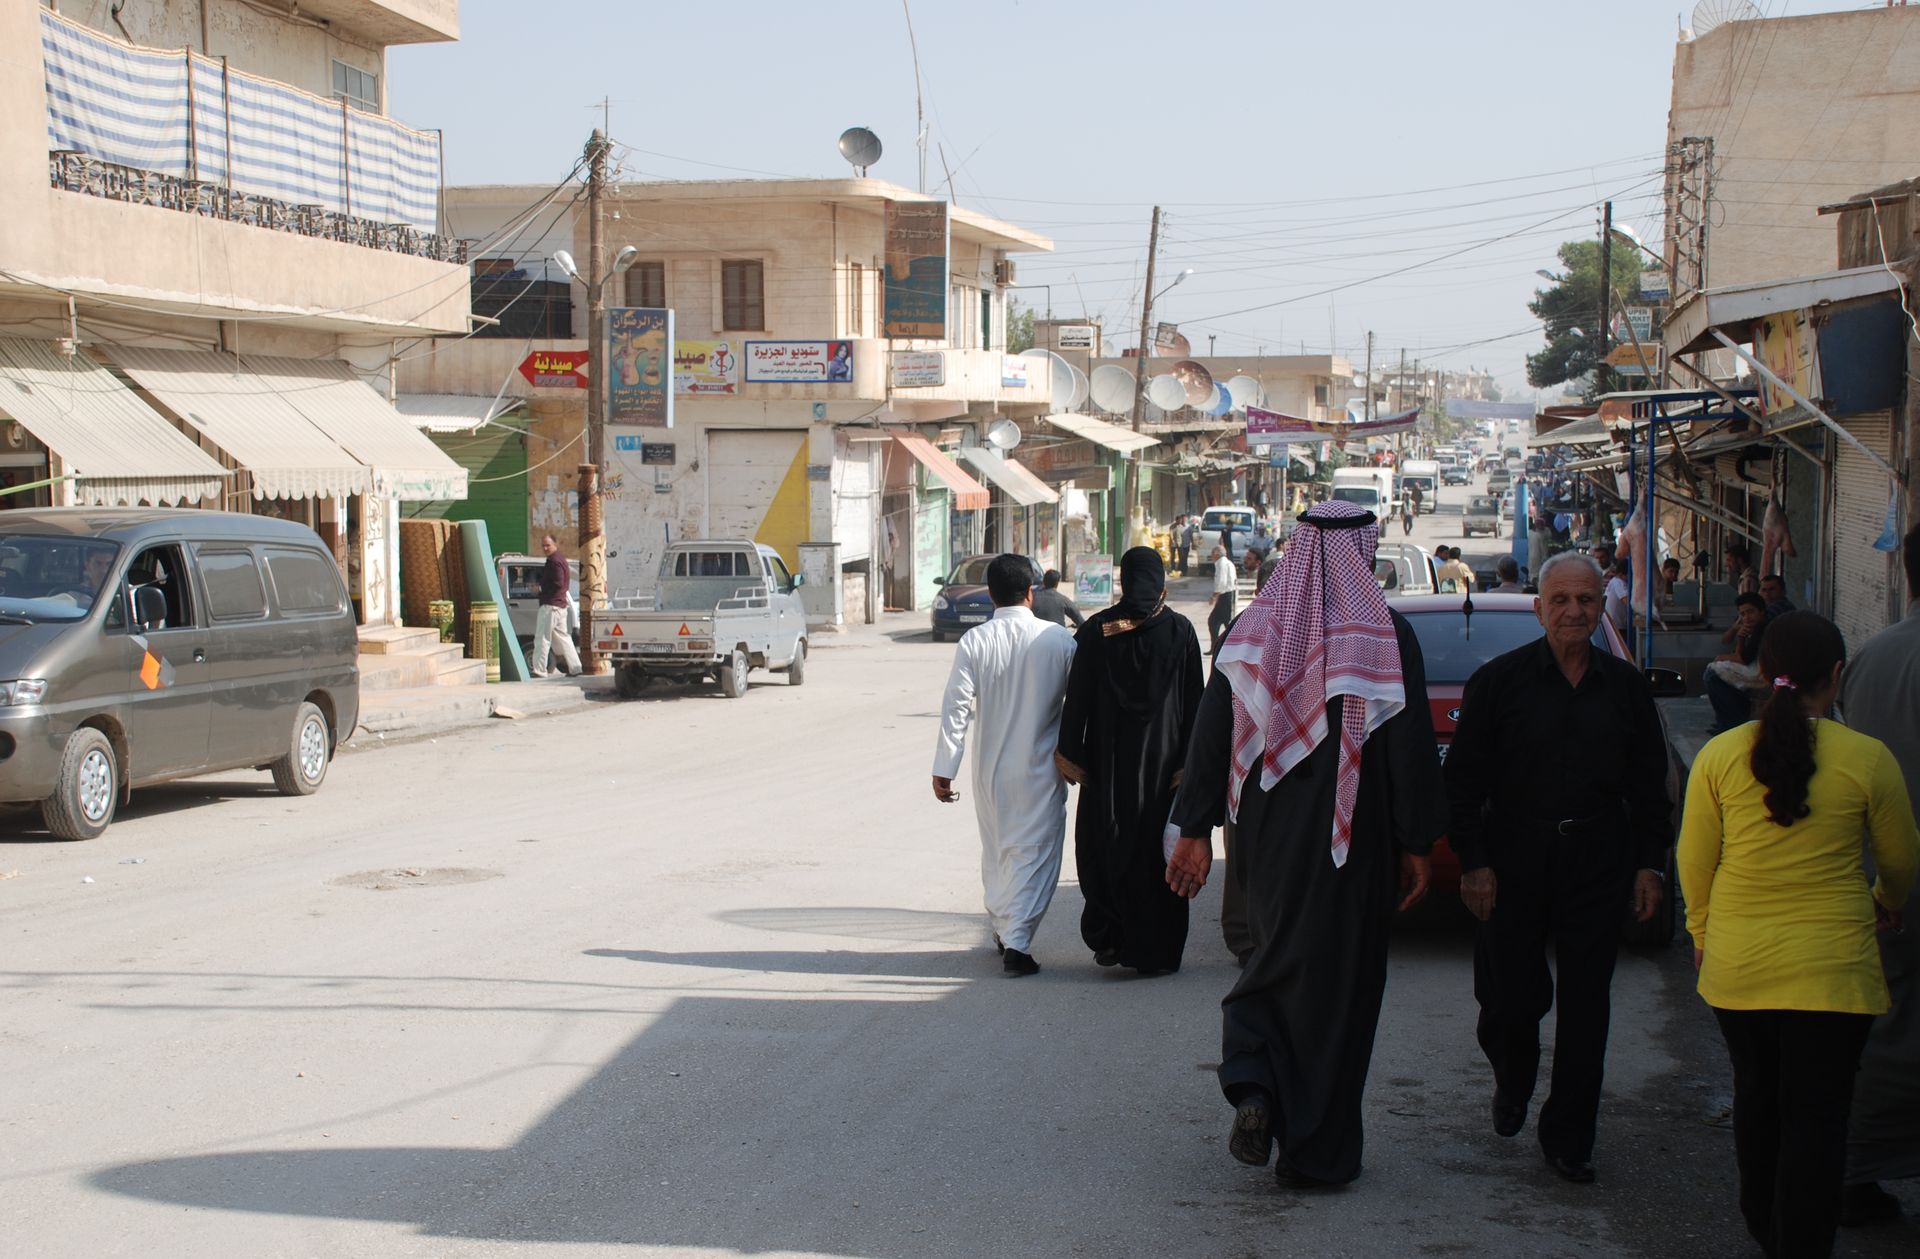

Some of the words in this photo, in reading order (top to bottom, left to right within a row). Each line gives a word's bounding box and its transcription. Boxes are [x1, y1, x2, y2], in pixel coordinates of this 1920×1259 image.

[1628, 307, 1648, 315] UPER
[674, 349, 706, 369] صيد
[754, 346, 787, 360] الجزيرة
[791, 346, 819, 359] ستوديو
[534, 352, 573, 374] صيدلية
